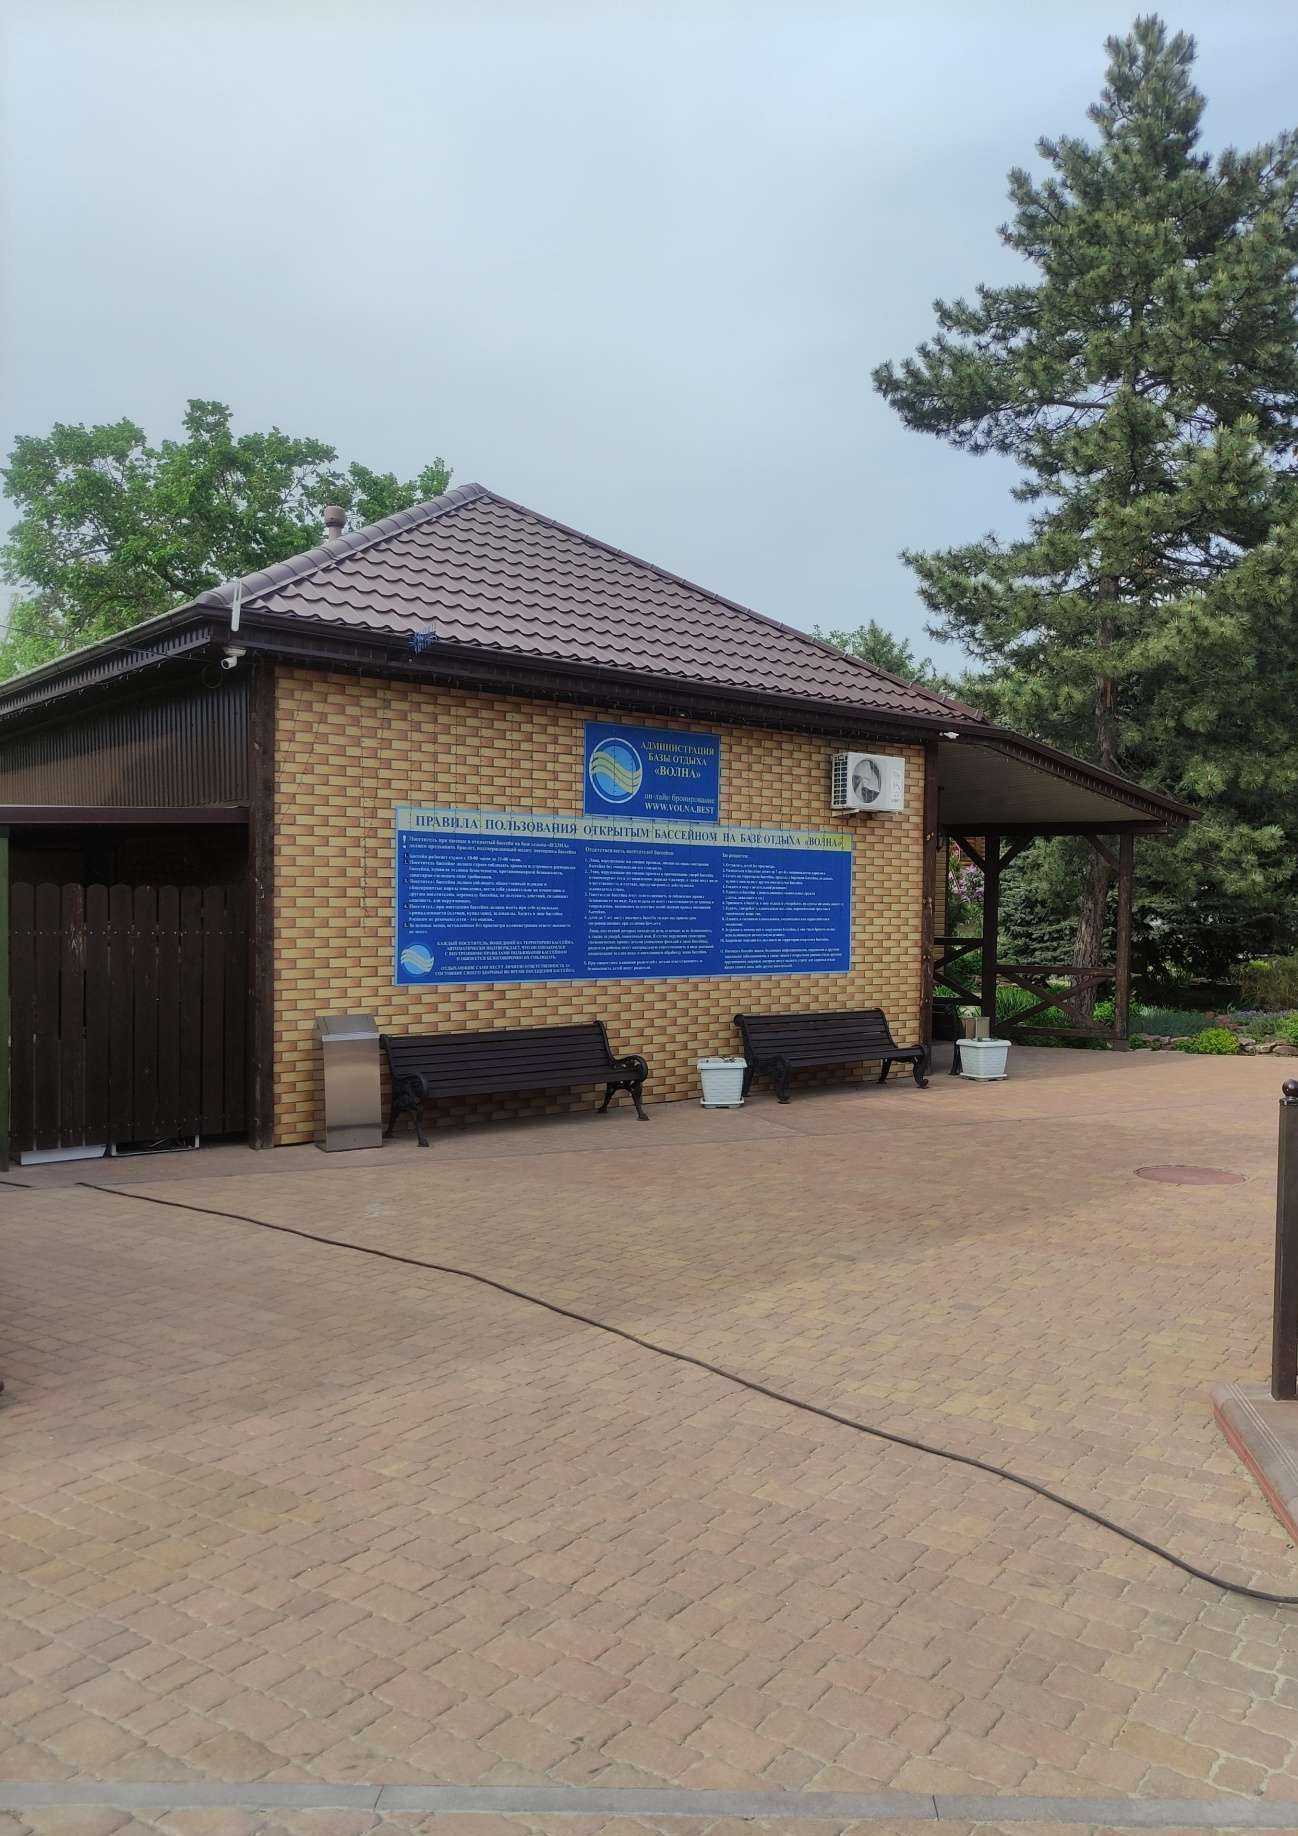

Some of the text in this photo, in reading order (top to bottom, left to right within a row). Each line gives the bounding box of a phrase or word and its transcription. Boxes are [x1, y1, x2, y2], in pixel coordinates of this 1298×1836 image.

[641, 741, 714, 756] АДМИНИСТРАЦИЯ
[648, 752, 707, 766] БАЗЫ ОТДЫХА
[654, 765, 701, 778] «ВОЛНА»
[644, 802, 714, 814] WWW.VOLNA.BEST
[415, 815, 844, 848] ПРАВИЛА ПОЛЬЗОВАНИЯ ОТКРЫТЫМ БАССЕЙНОМ НА БАЗЕ ОТДЫХА «ВОЛНА»
